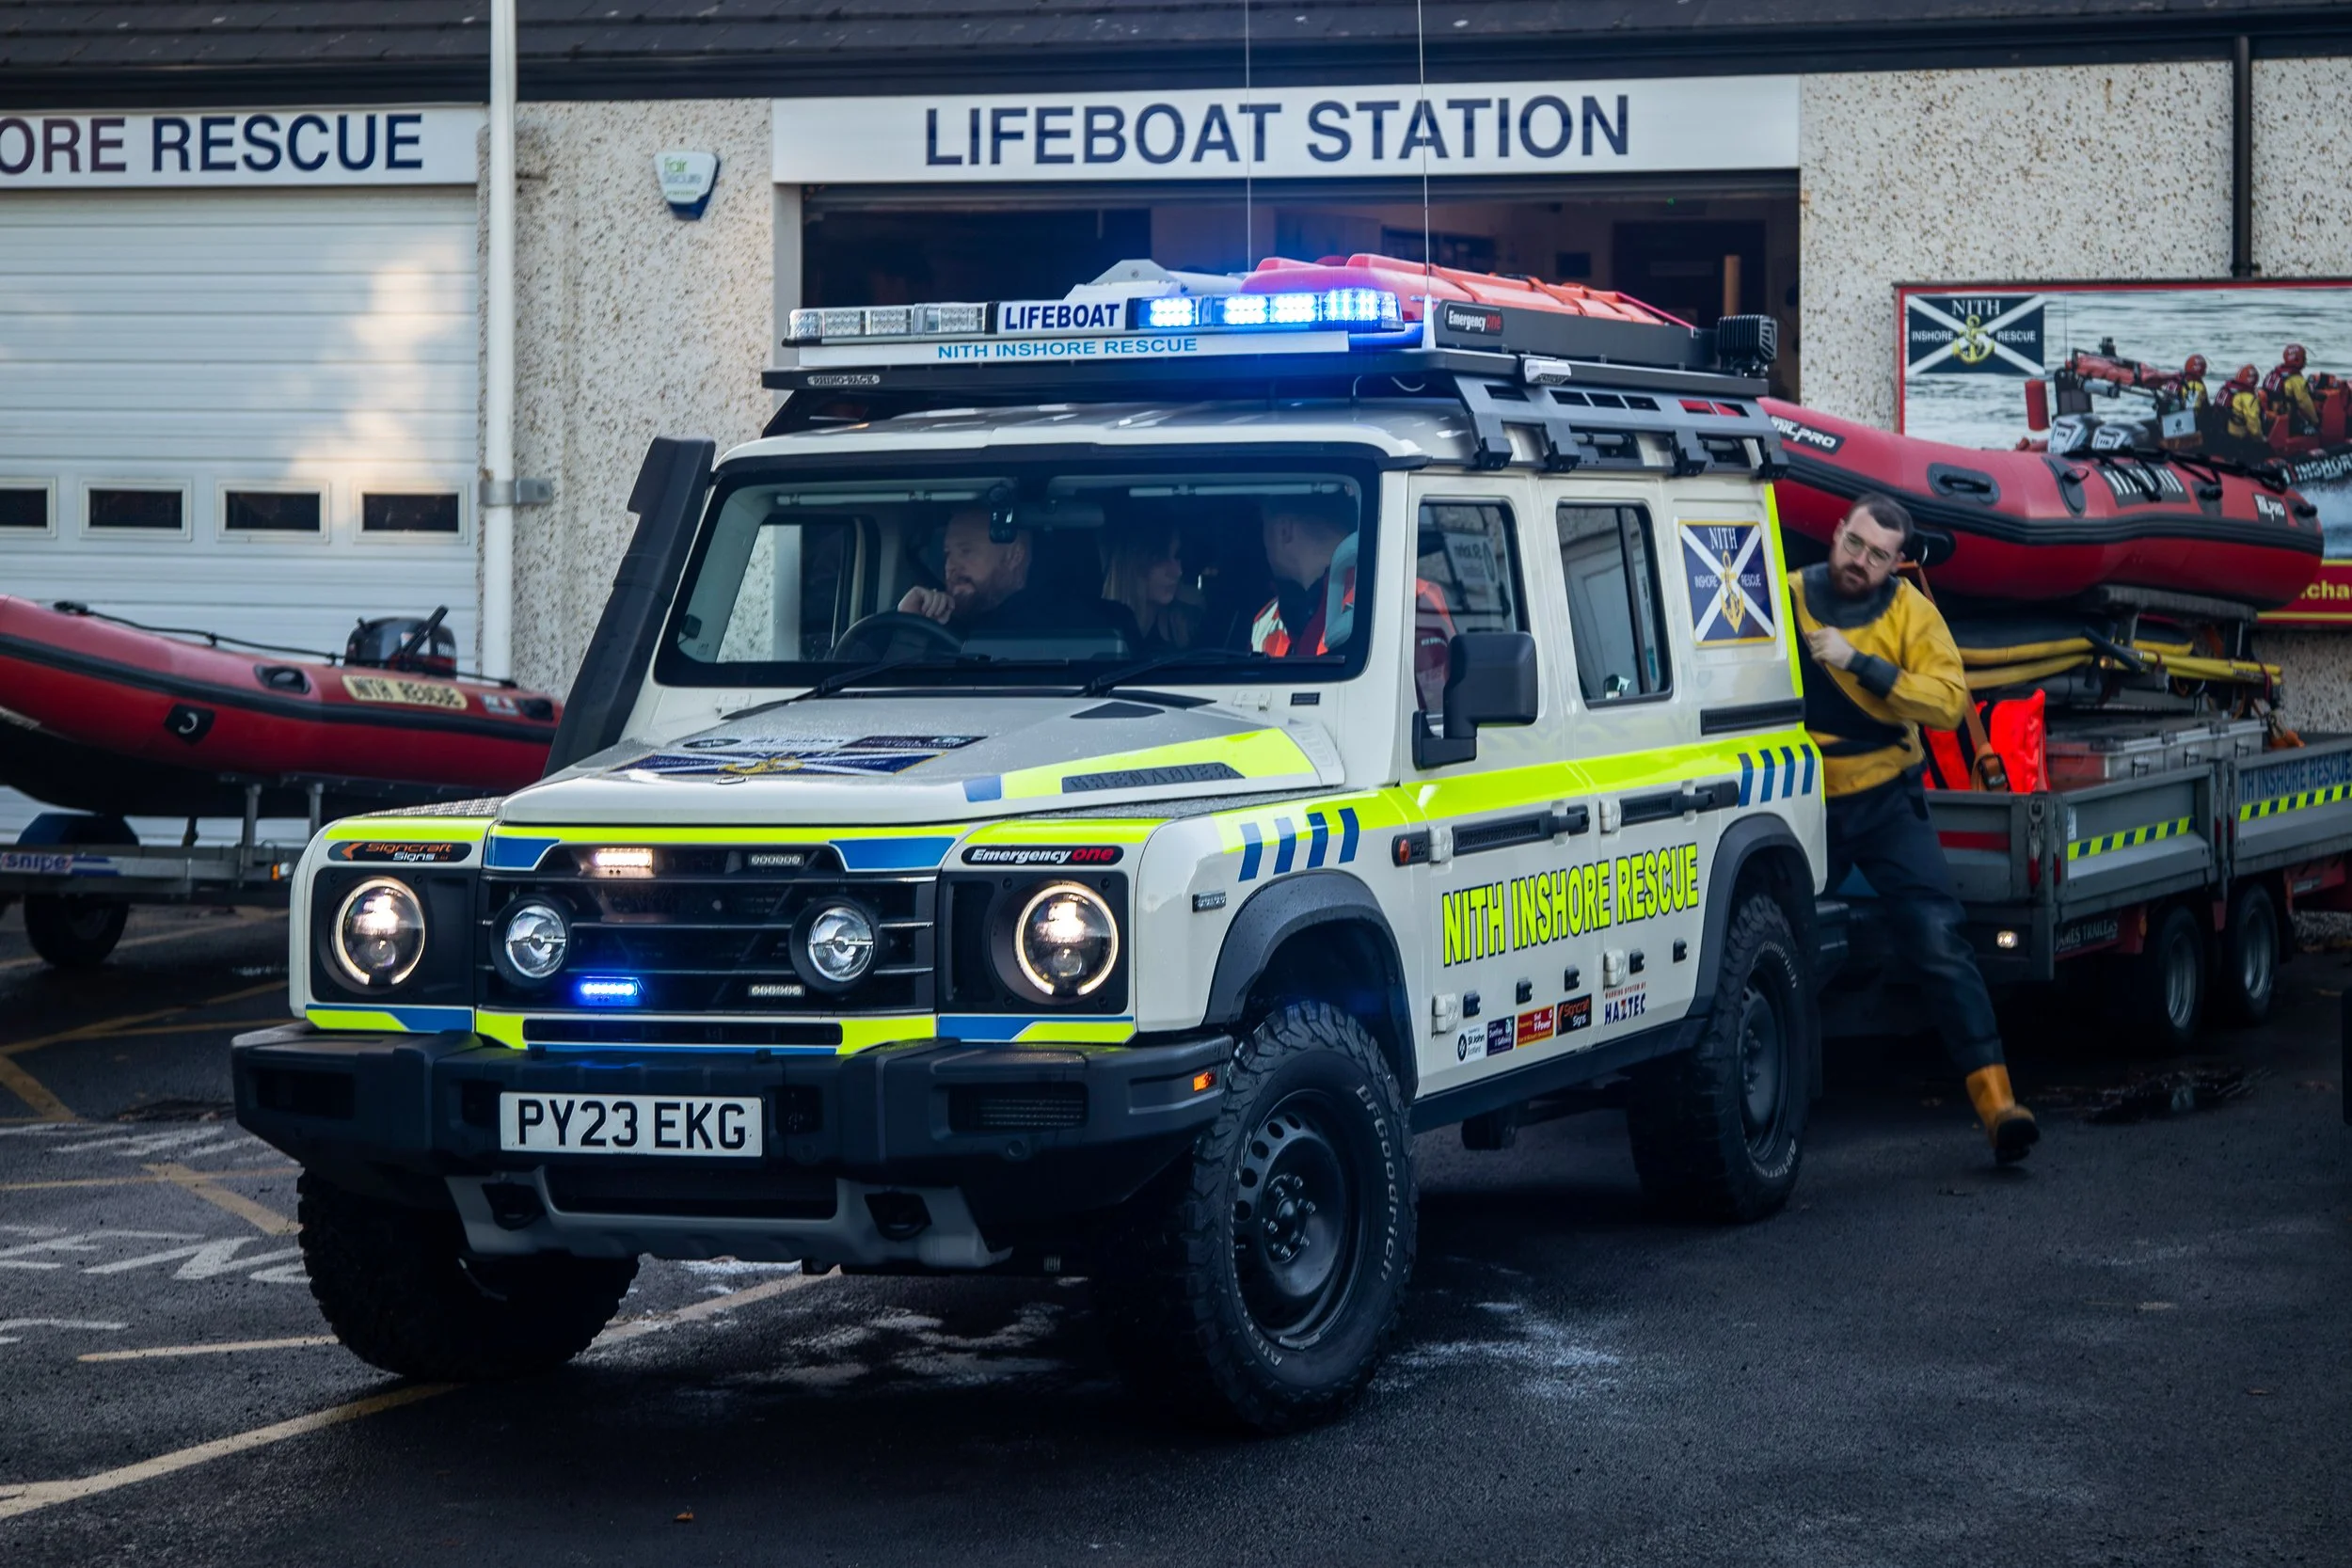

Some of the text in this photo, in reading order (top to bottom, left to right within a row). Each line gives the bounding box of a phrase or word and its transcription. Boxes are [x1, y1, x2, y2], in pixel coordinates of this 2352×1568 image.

[926, 95, 1629, 166] LIFEBOAT STATION
[0, 114, 423, 175] ORE RESCUE
[1005, 304, 1120, 330] LIFEBOAT
[1951, 299, 2000, 317] NITH
[1449, 309, 1486, 333] Emergency
[938, 338, 1198, 358] NITH INSHORE RESCUE
[1912, 330, 2036, 342] INSHORE RESCUE
[2295, 451, 2352, 482] INSHOR
[1708, 527, 1739, 550] NITH
[2239, 751, 2352, 802] TH INSHORE RESCUE
[366, 843, 453, 854] Signcraft
[393, 852, 435, 863] Signs
[970, 848, 1073, 864] Emergency
[1442, 843, 1700, 968] NITH INSHORE RESCUE
[1604, 992, 1646, 1026] HAZTEC
[517, 1099, 746, 1149] PY23 EKG
